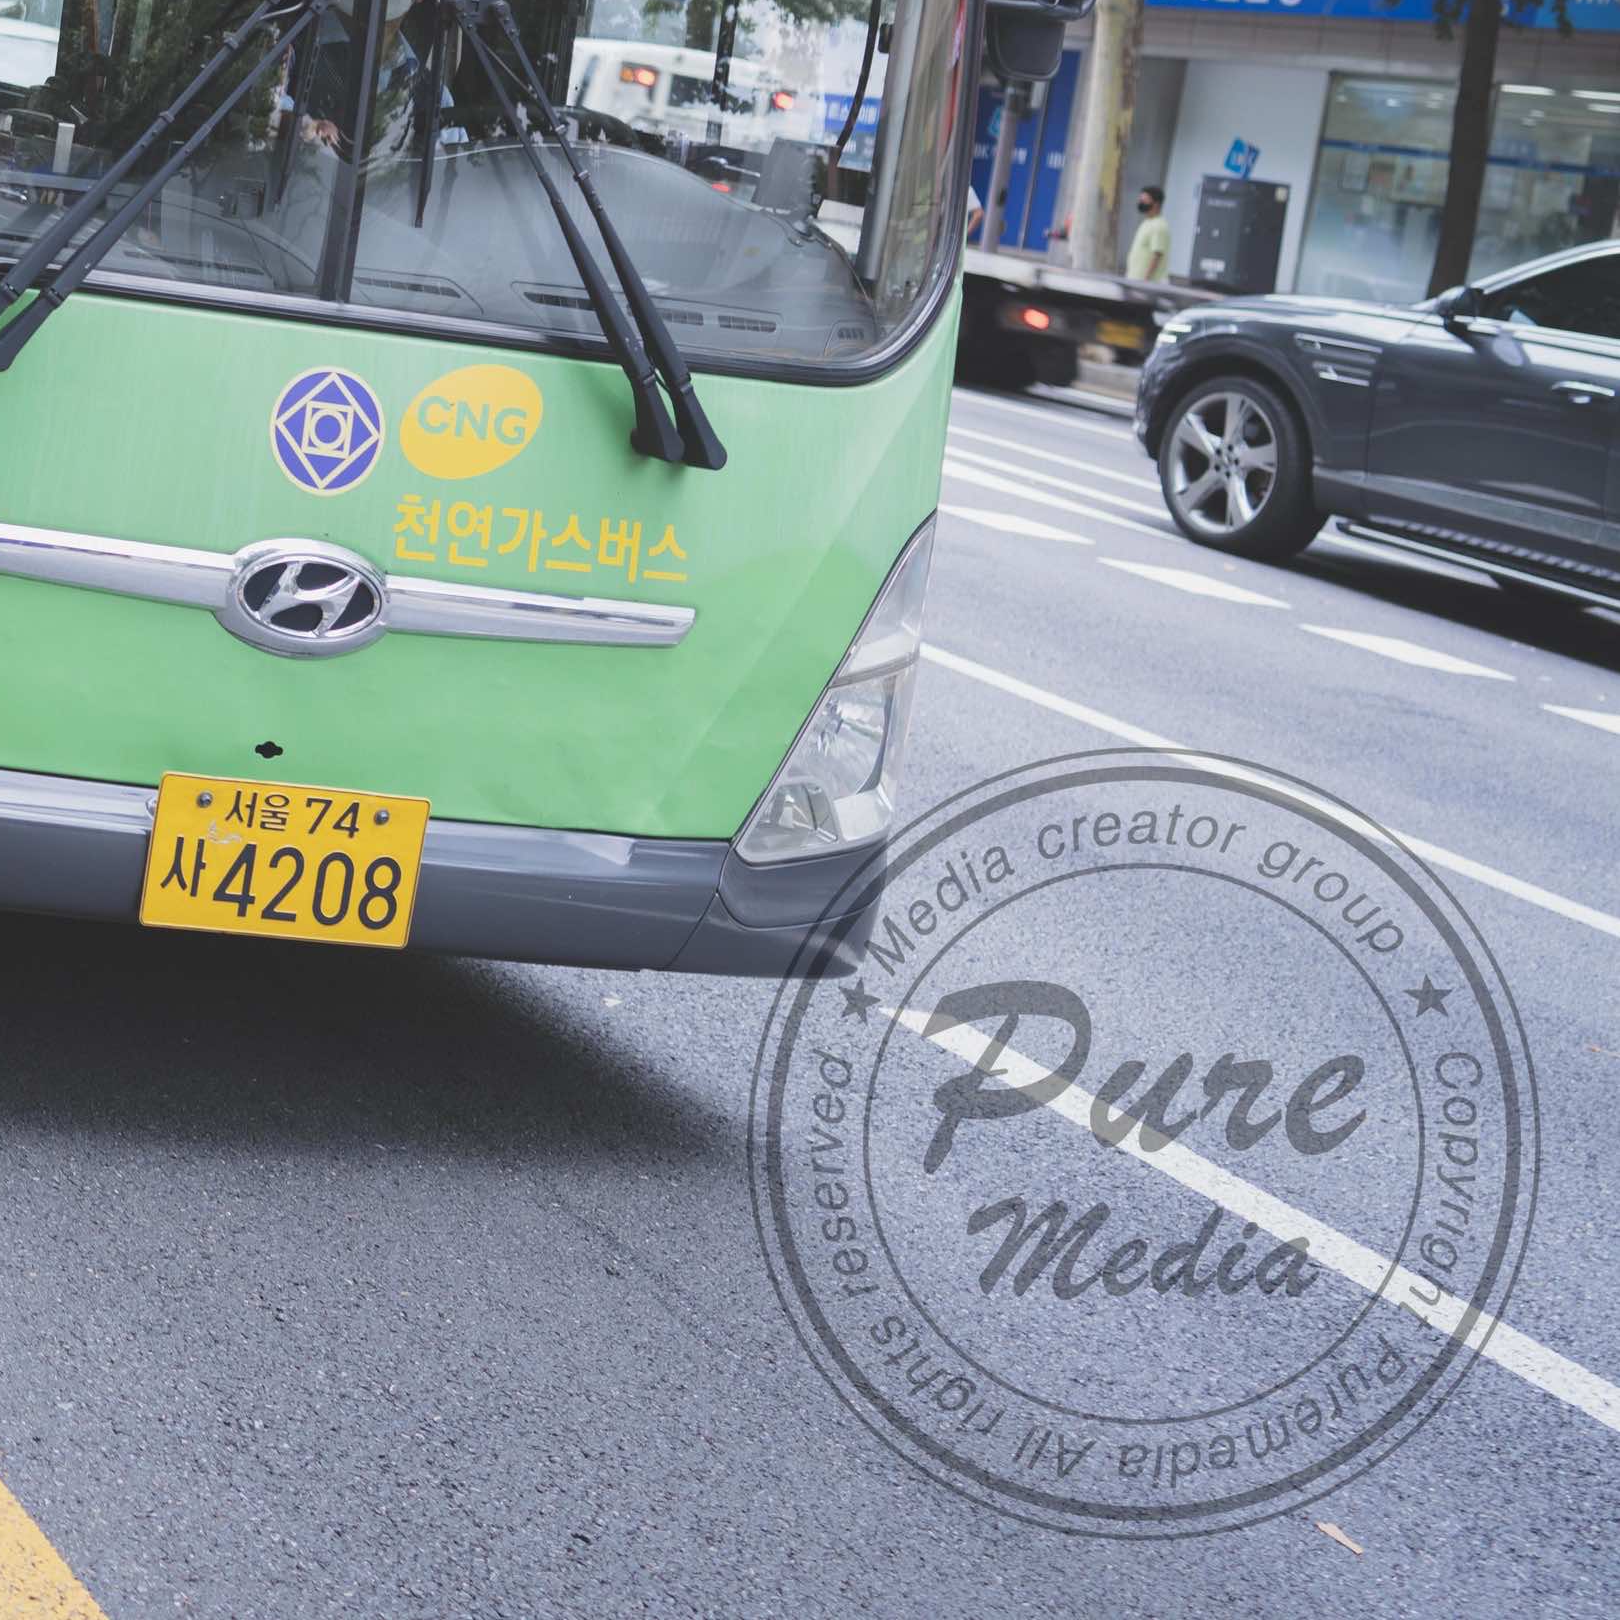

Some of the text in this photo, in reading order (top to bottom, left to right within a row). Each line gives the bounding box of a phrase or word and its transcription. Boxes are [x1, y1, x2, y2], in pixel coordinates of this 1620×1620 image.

[417, 394, 528, 446] CNG
[393, 493, 688, 585] 천연가스버스
[225, 788, 361, 839] 서울 74
